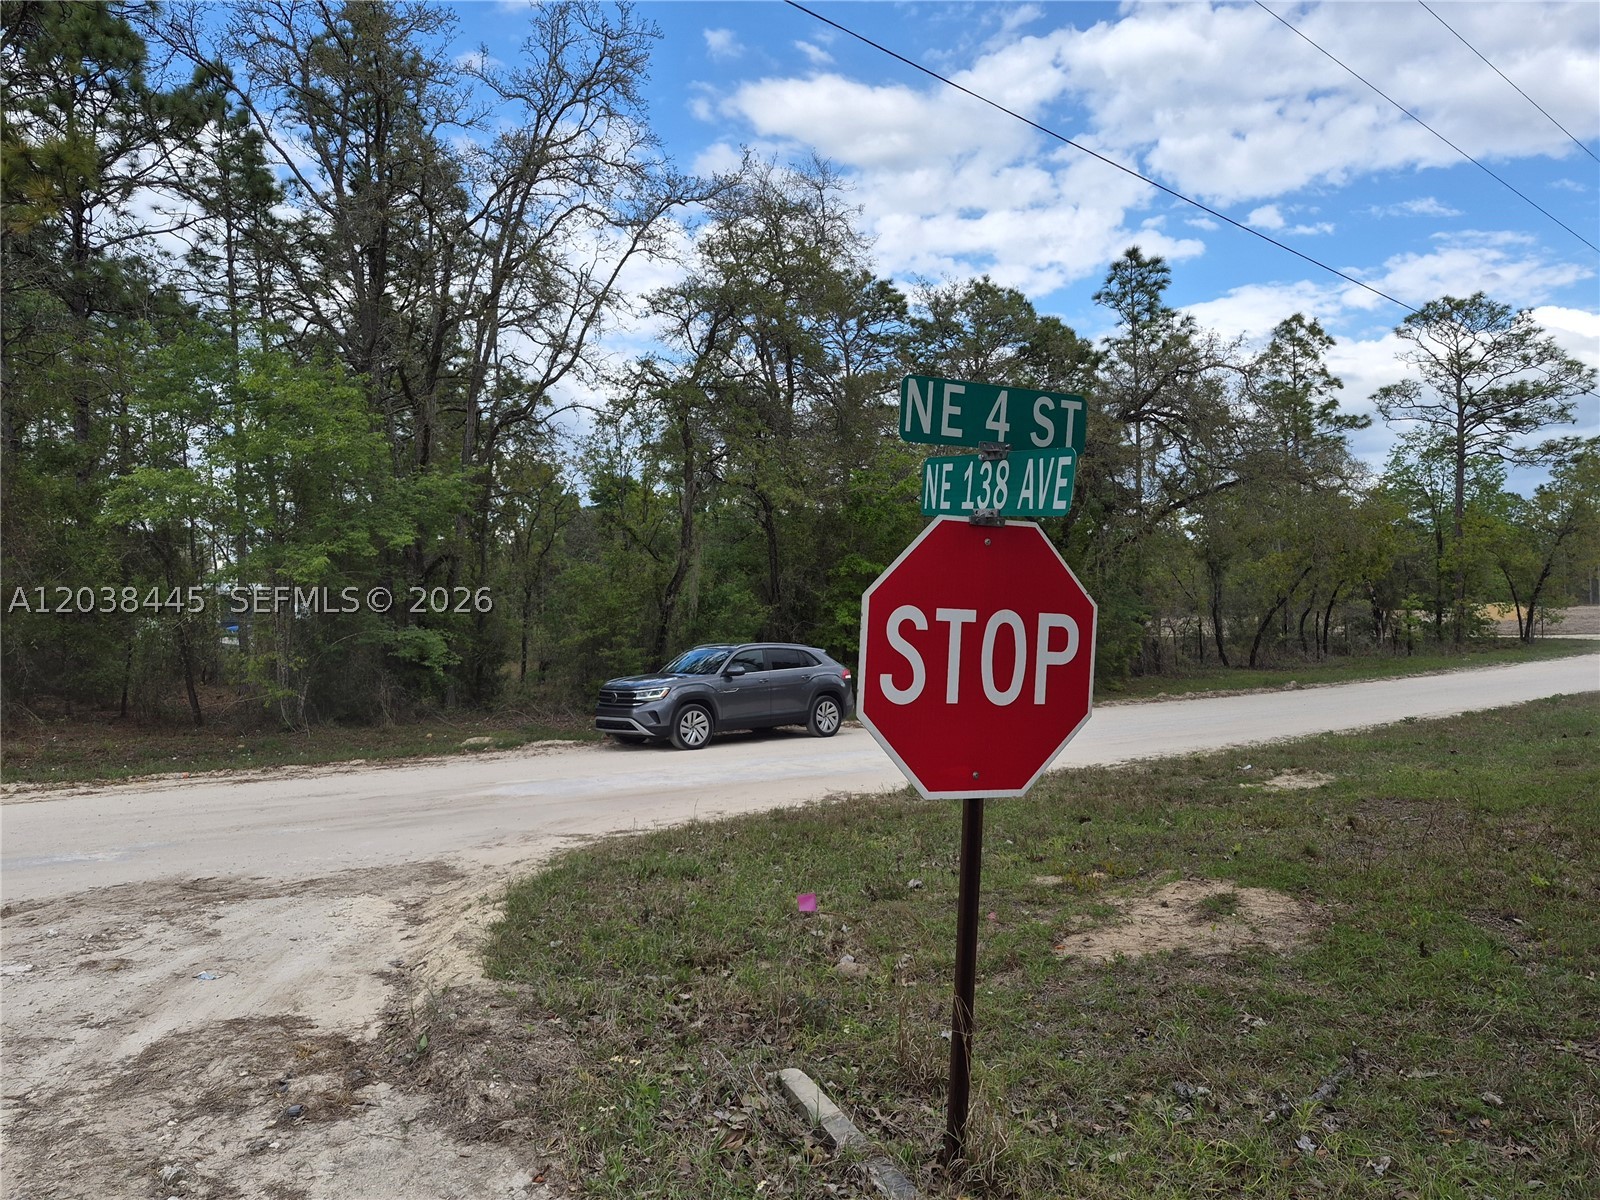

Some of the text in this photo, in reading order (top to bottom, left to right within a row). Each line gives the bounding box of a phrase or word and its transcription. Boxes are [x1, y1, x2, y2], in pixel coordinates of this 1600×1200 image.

[905, 378, 1083, 448] NE 4 ST
[924, 456, 1072, 510] NE 138 AVE
[879, 604, 1080, 706] STOP
